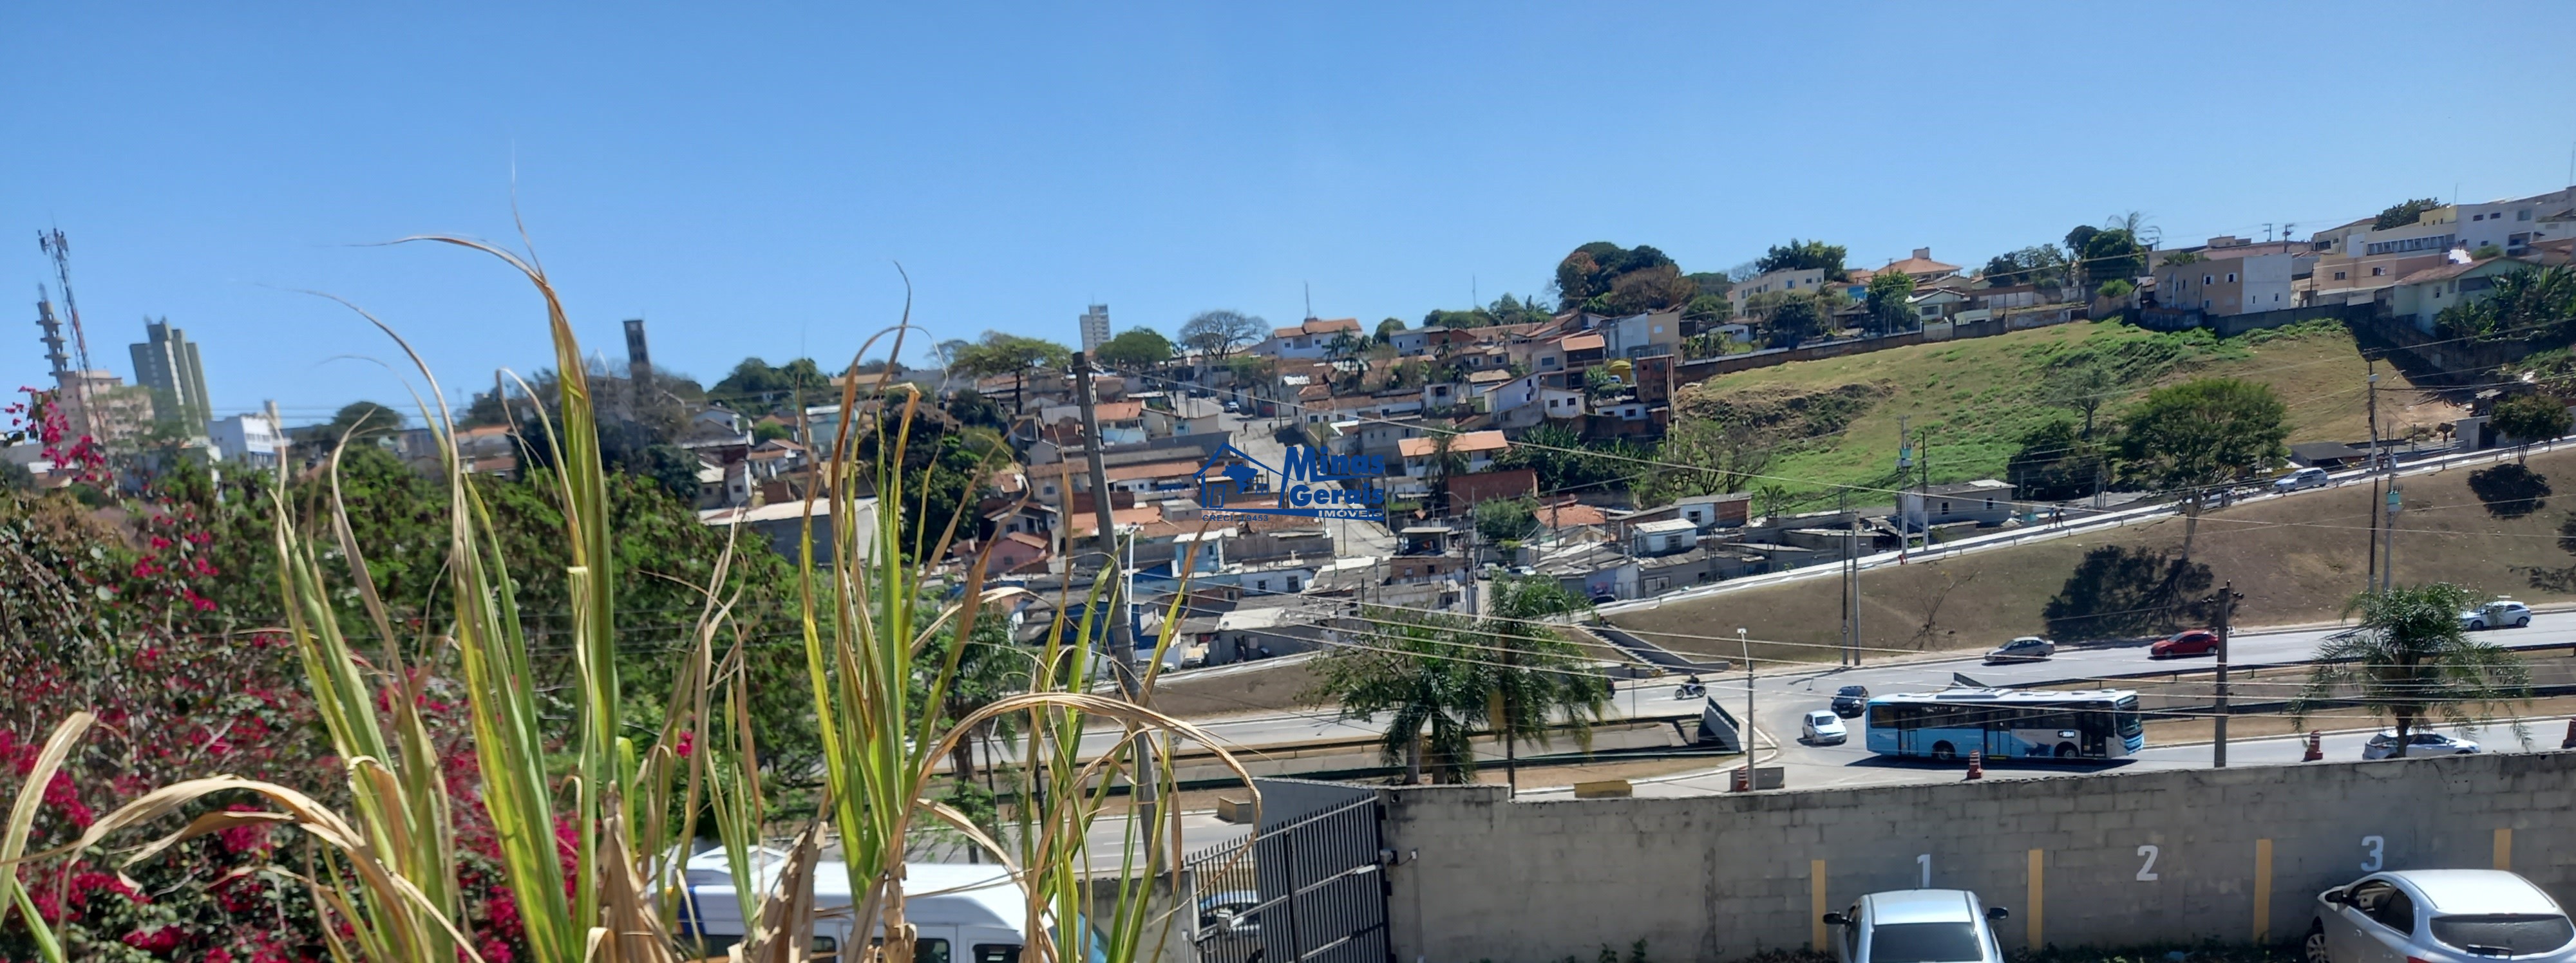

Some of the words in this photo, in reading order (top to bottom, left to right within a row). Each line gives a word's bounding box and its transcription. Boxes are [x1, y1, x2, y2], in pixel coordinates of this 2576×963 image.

[1917, 854, 1931, 888] 1
[2136, 845, 2158, 881] 2
[2360, 836, 2384, 872] 3
